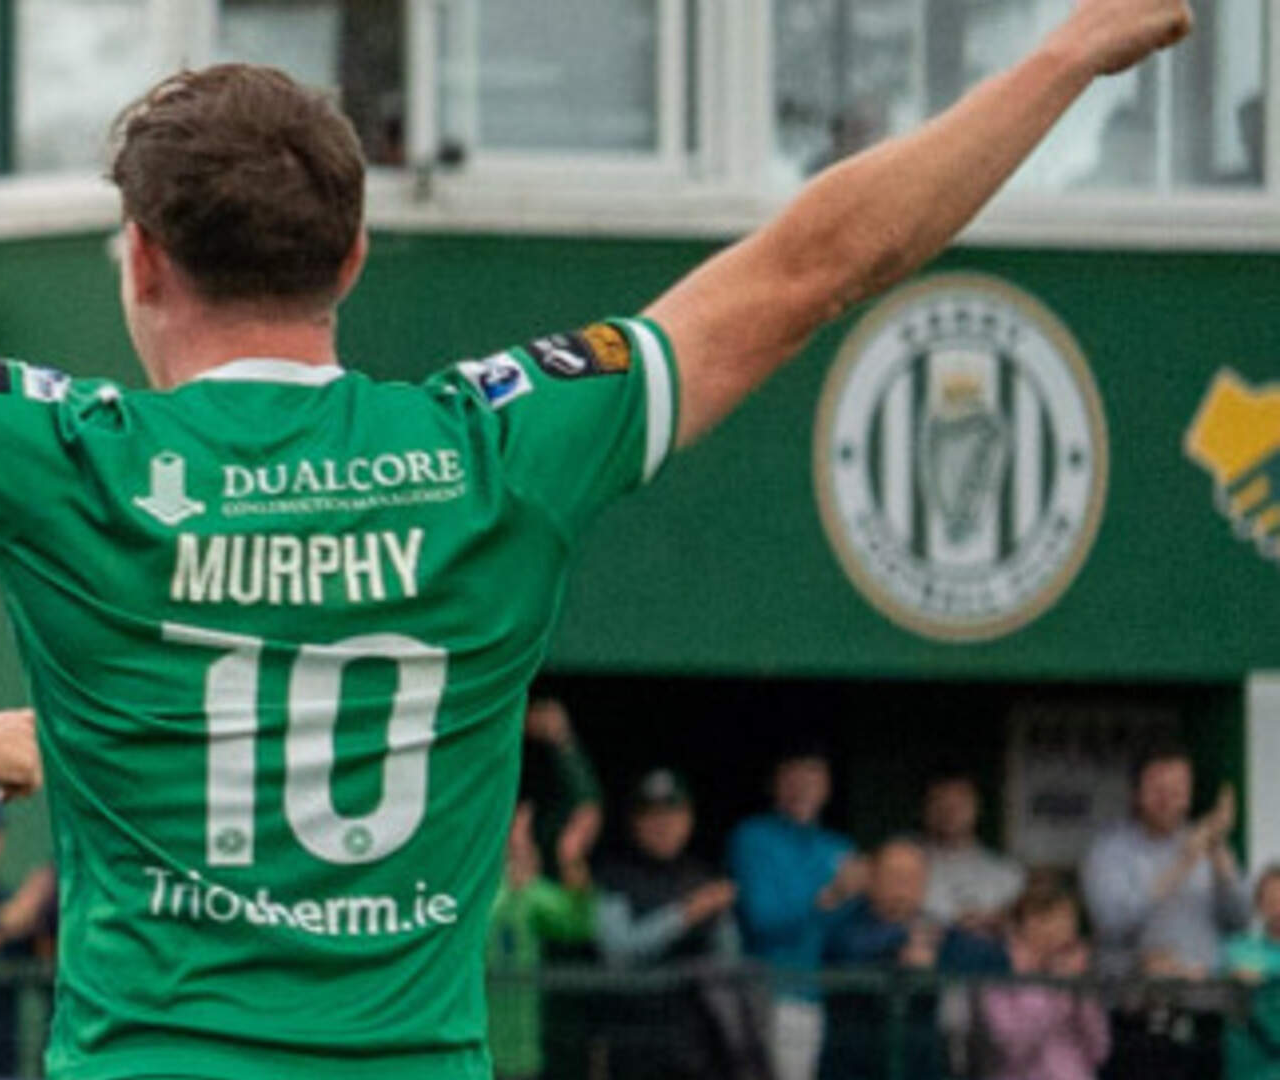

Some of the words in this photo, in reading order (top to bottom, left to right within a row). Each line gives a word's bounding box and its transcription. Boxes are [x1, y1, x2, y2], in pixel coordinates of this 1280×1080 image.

[222, 450, 465, 498] DUALCORE
[171, 527, 423, 604] MURPHY
[160, 621, 448, 866] 10
